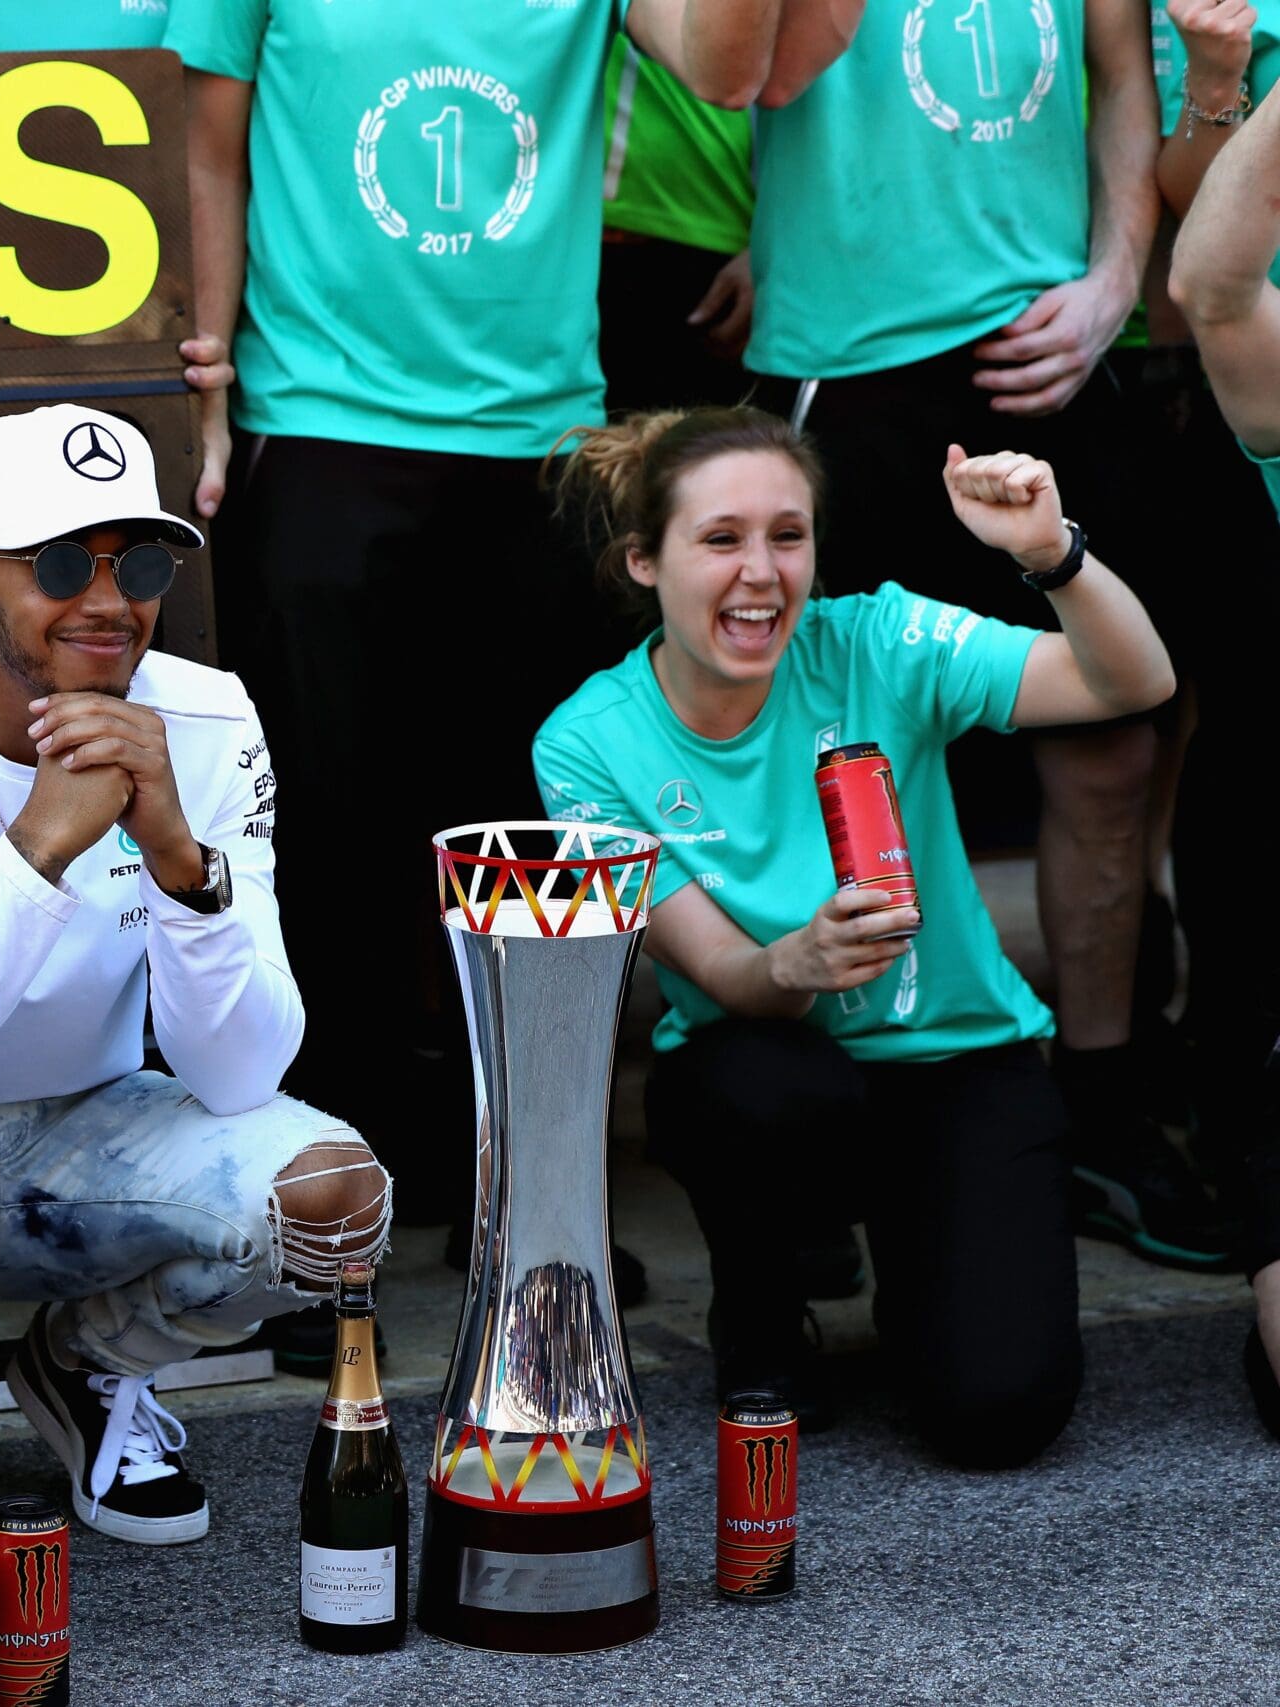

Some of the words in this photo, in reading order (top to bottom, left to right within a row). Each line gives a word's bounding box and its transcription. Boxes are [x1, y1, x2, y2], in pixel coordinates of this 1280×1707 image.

[954, 0, 1000, 97] 1
[380, 77, 410, 109] GP
[411, 65, 520, 114] WINNERS
[970, 116, 1014, 142] 2017
[421, 105, 463, 211] 1
[418, 231, 473, 255] 2017
[697, 871, 725, 890] BS
[733, 1413, 758, 1423] LEWIS
[1, 1520, 28, 1530] LEWIS
[320, 1564, 367, 1573] CHAMPAGNE
[309, 1577, 382, 1592] Laurent-Perrier
